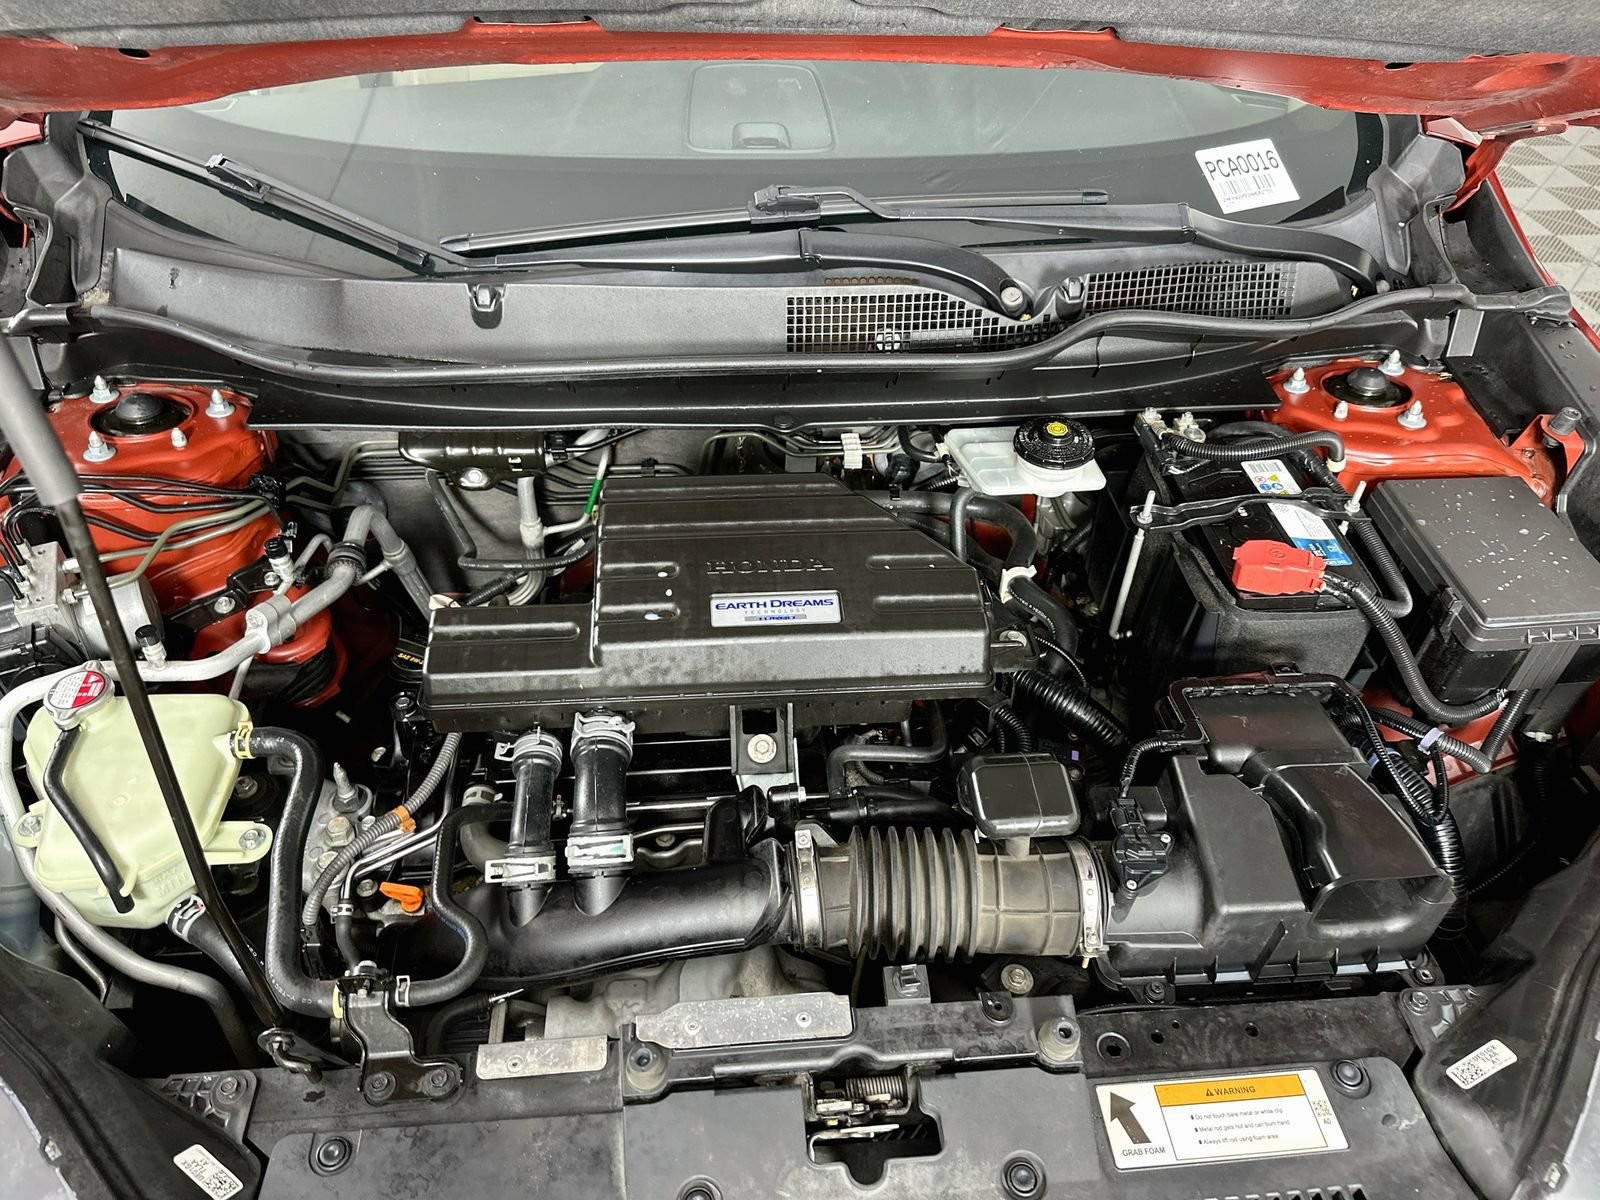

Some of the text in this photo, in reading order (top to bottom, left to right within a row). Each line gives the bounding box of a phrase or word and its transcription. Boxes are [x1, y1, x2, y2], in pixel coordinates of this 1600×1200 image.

[1205, 150, 1279, 181] PCA0016
[706, 558, 834, 574] HONDA
[715, 599, 834, 610] EARTH DREAMS
[1214, 1086, 1256, 1096] WARNING
[1122, 1146, 1166, 1157] GRAB FOAM
